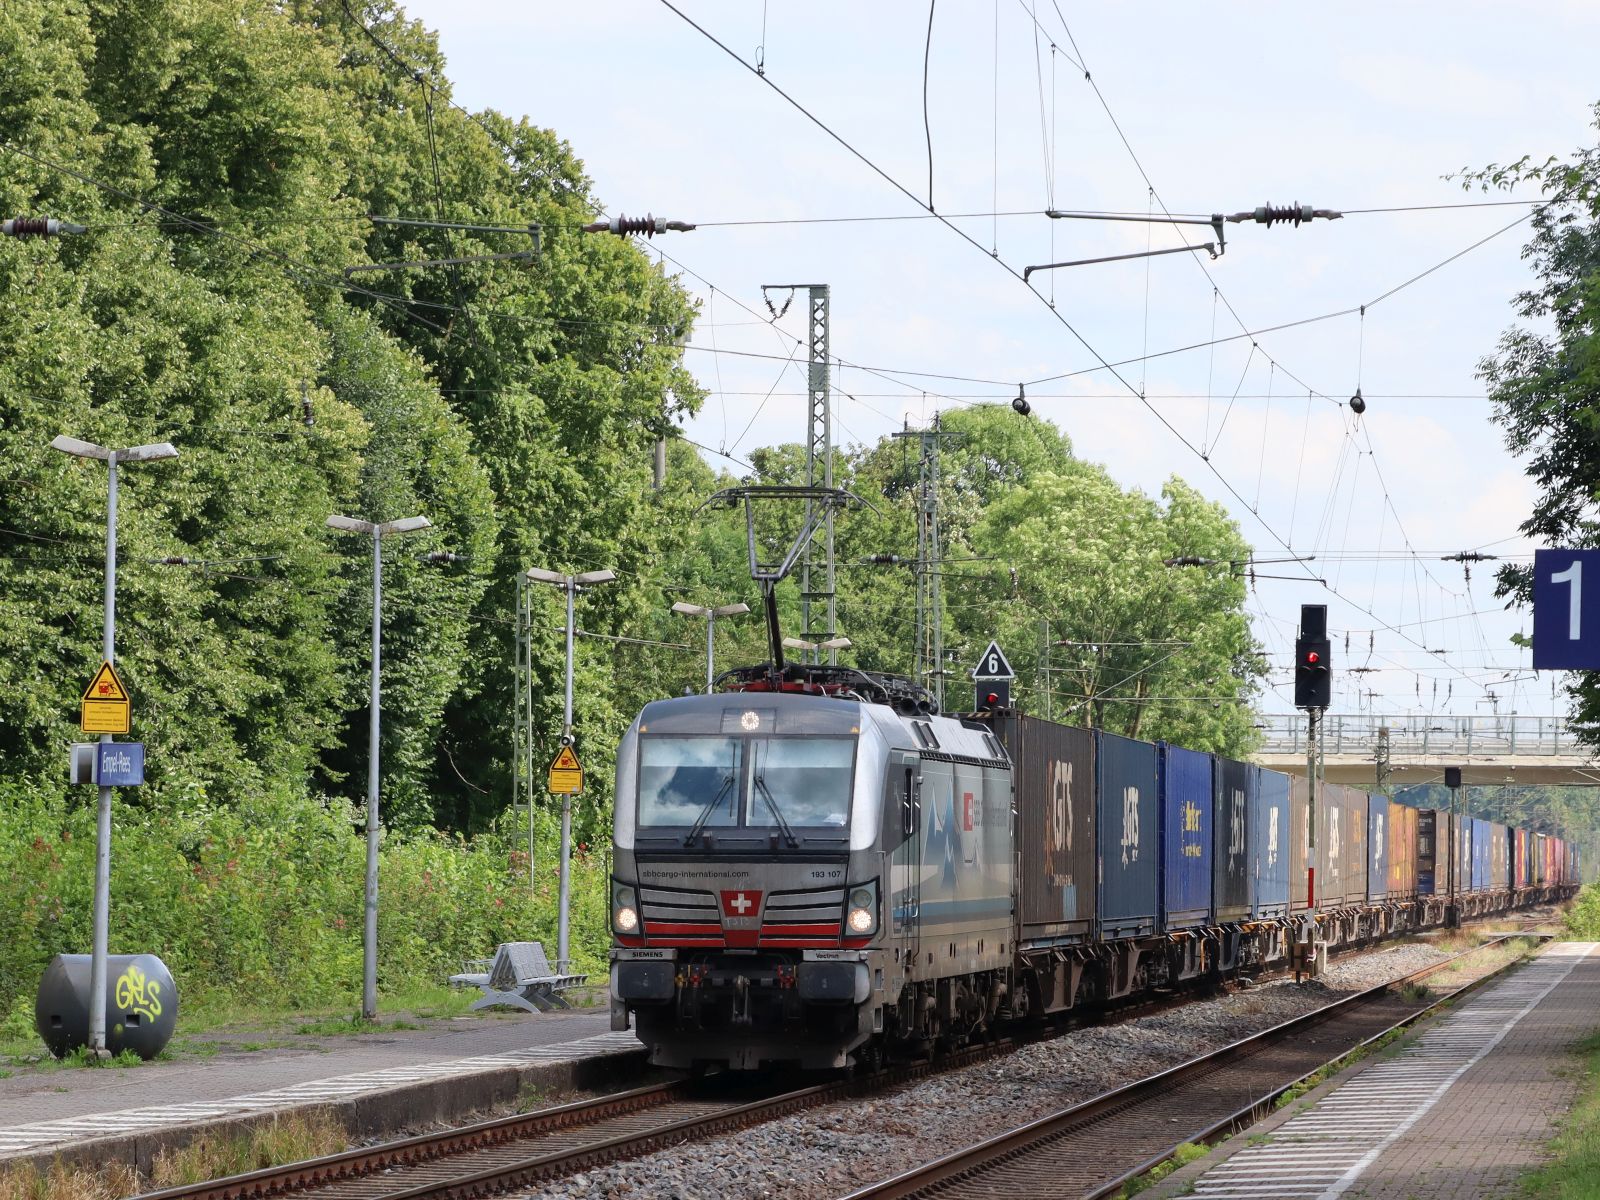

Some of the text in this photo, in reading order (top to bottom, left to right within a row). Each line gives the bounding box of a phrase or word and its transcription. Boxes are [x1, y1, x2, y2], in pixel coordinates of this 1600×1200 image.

[1551, 560, 1582, 640] 1
[988, 653, 999, 674] 6
[102, 751, 131, 779] Empel-Rees
[642, 870, 749, 879] sbbcargo-international.com
[828, 870, 841, 878] 107
